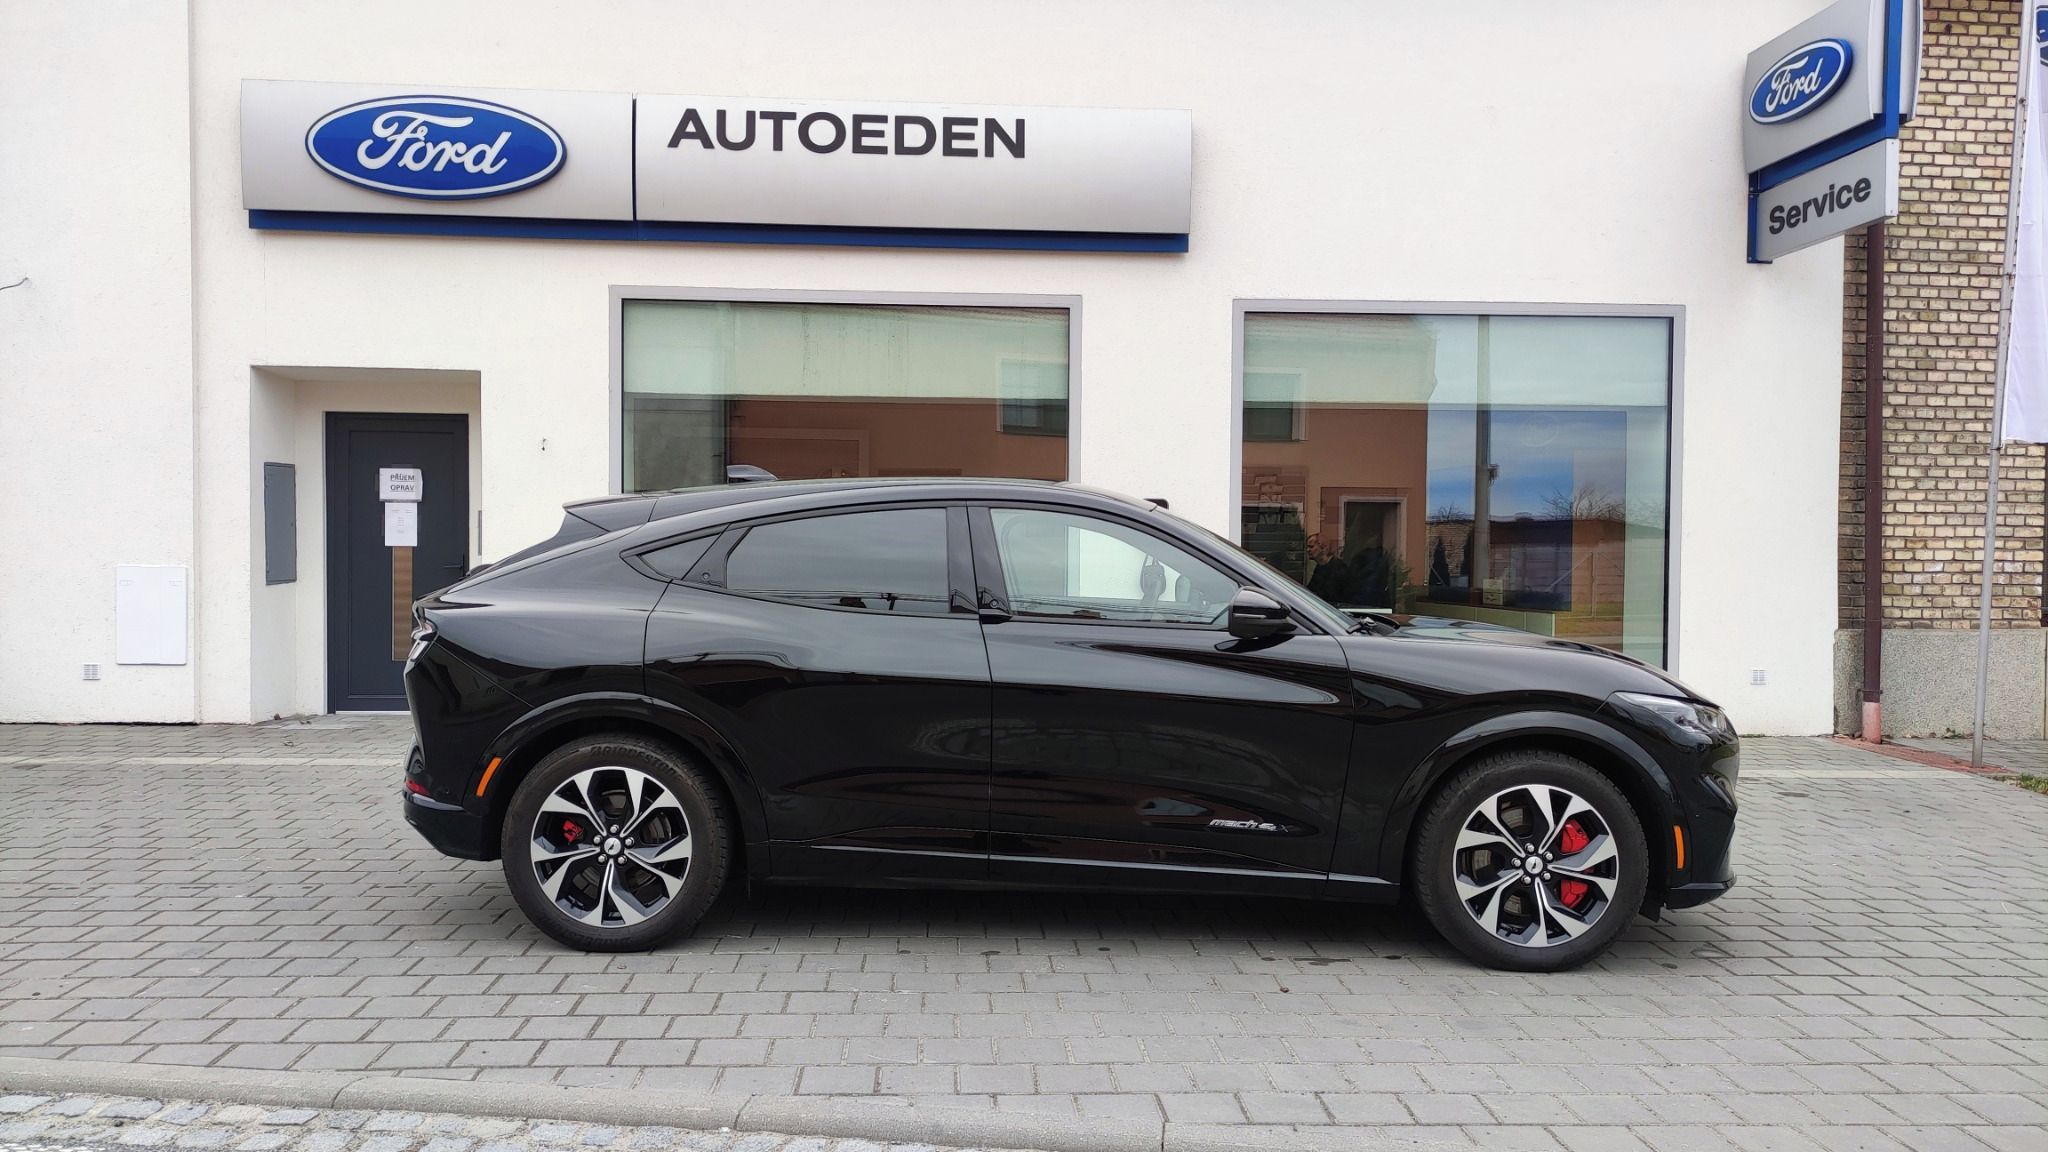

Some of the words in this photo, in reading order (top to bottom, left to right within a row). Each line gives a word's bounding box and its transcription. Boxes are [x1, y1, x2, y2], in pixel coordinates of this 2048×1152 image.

[1766, 56, 1823, 112] Ford
[357, 111, 511, 174] Ford
[667, 108, 1025, 158] AUTOEDEN
[1769, 177, 1871, 235] Service
